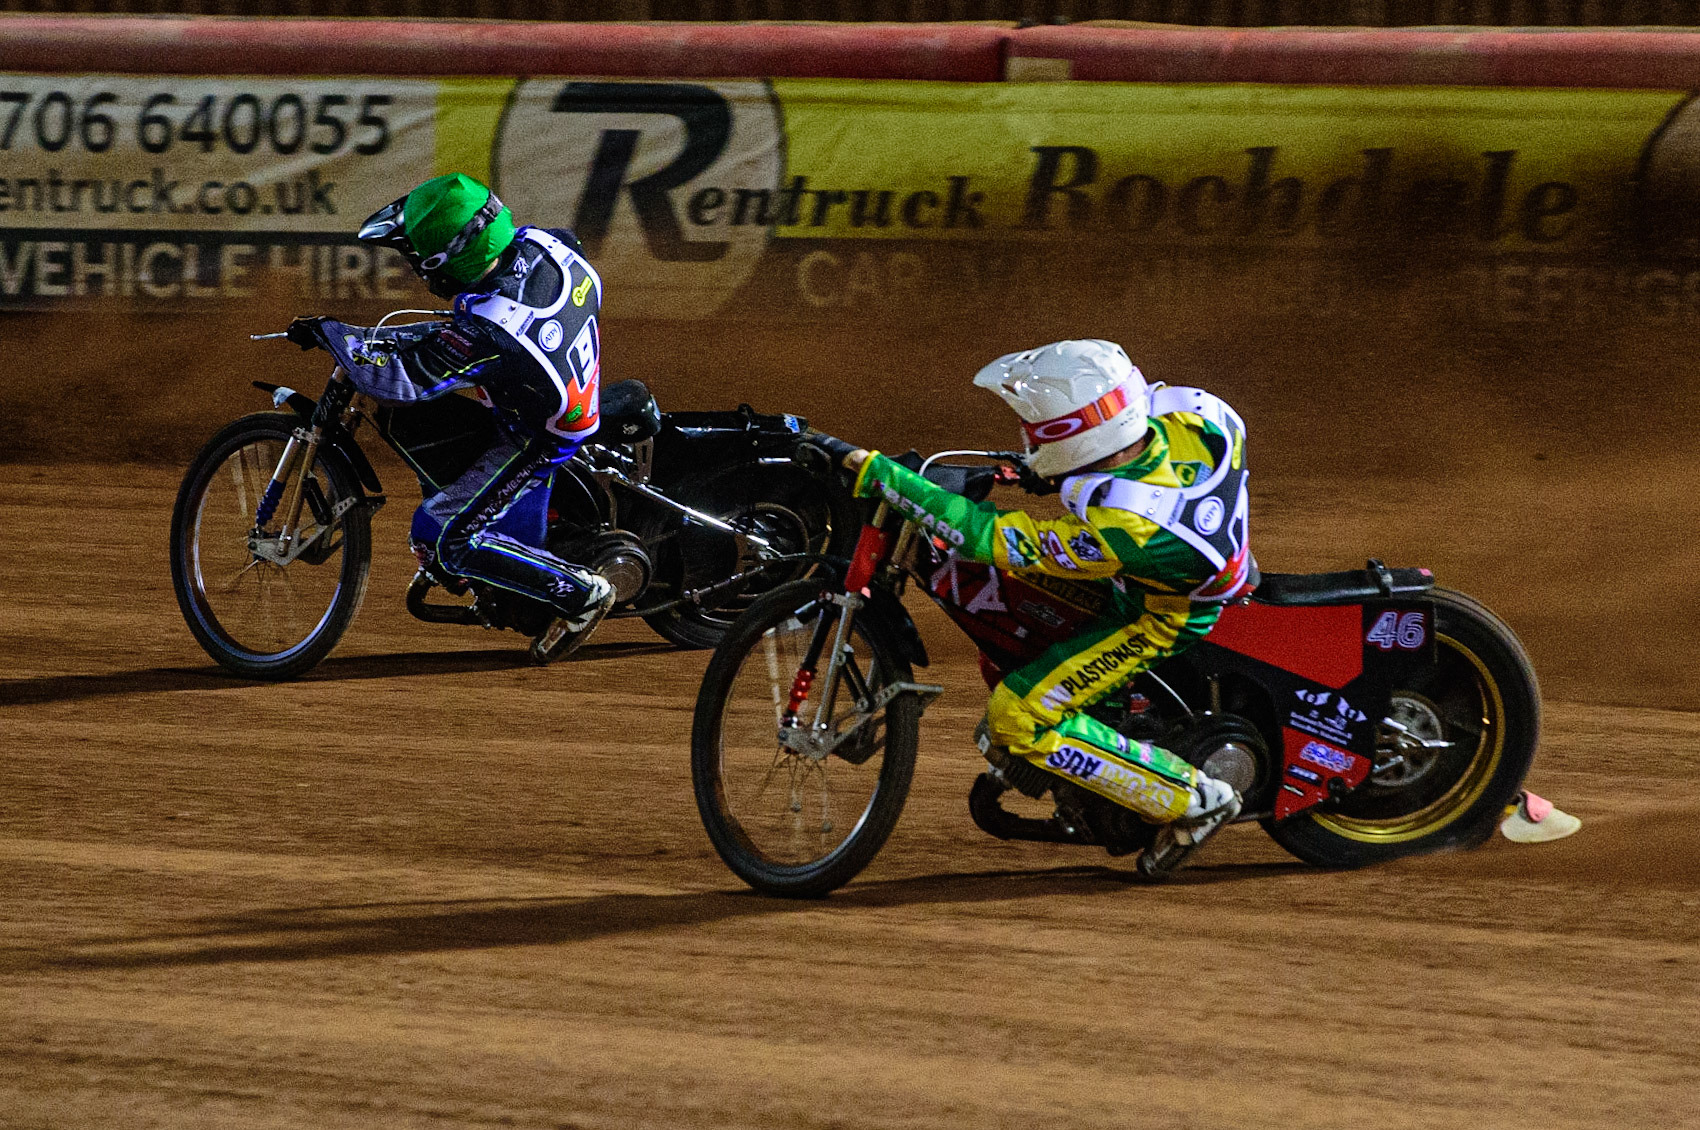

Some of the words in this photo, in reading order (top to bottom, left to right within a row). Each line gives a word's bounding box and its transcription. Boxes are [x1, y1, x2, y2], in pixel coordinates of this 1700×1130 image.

[0, 90, 116, 153] 706
[137, 93, 393, 155] 640055
[0, 241, 256, 298] VEHICLE
[270, 244, 407, 300] HIRE
[1366, 611, 1426, 649] 46
